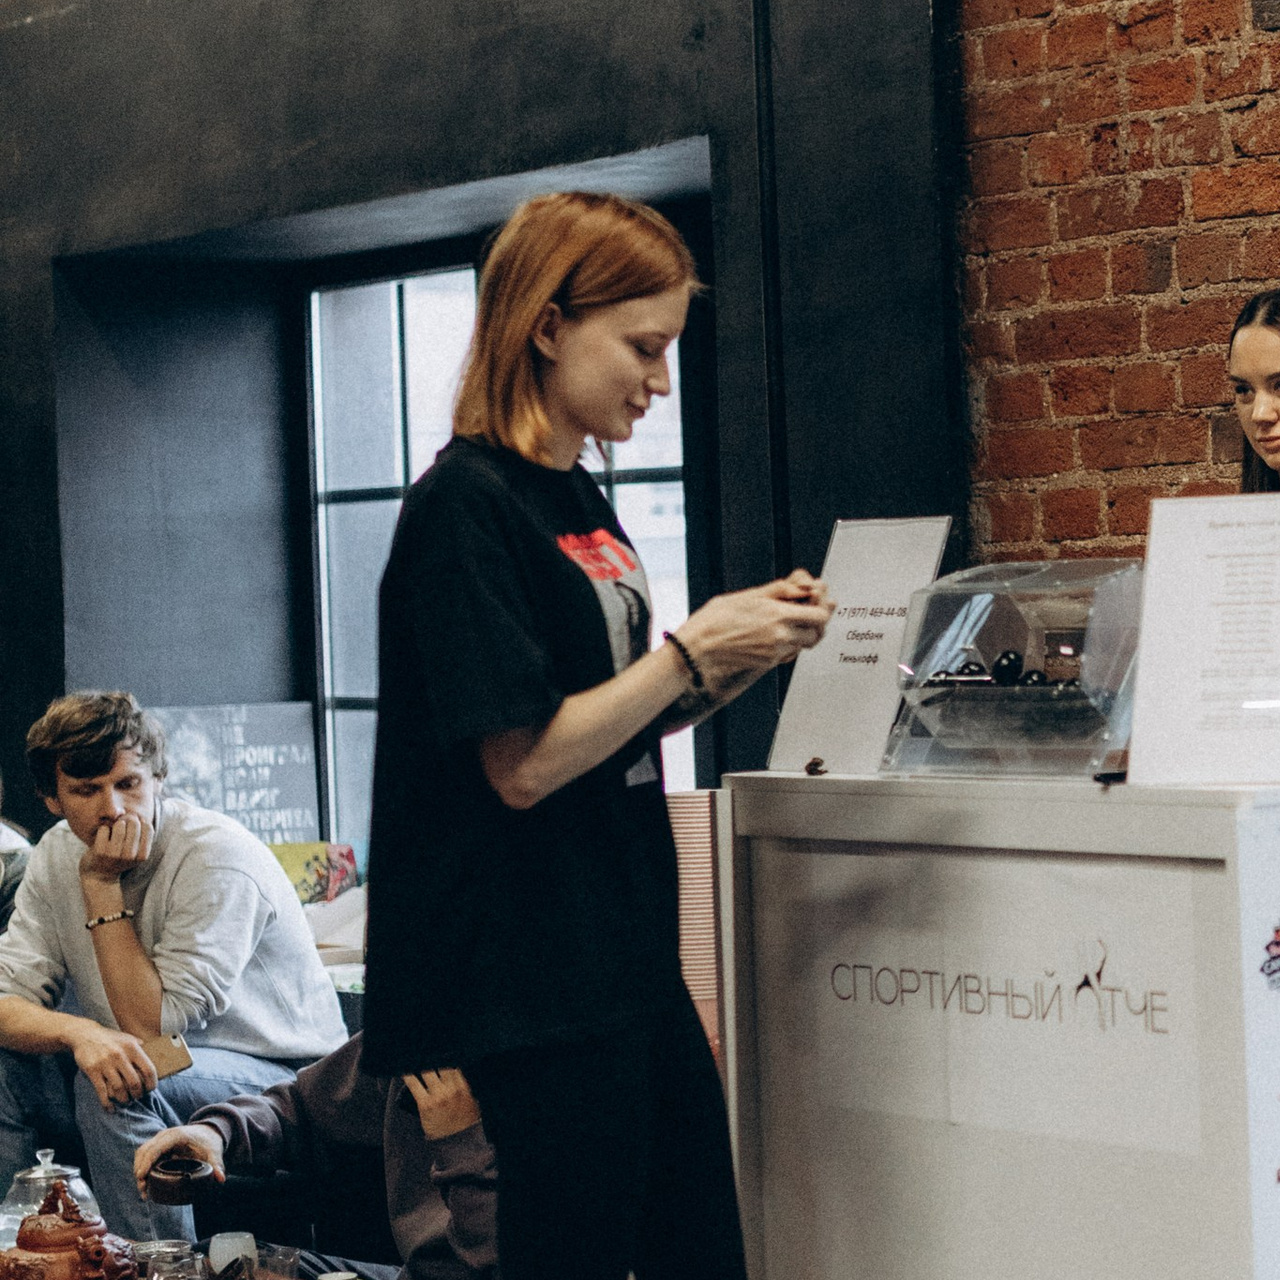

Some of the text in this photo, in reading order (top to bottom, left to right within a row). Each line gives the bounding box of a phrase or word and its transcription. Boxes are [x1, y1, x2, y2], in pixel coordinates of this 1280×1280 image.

[838, 607, 848, 617] +7
[847, 606, 868, 619] (977)
[846, 629, 884, 642] Сбербанк
[839, 652, 878, 665] Тинькофф
[831, 963, 1063, 1023] СПОРТИВНЫЙ
